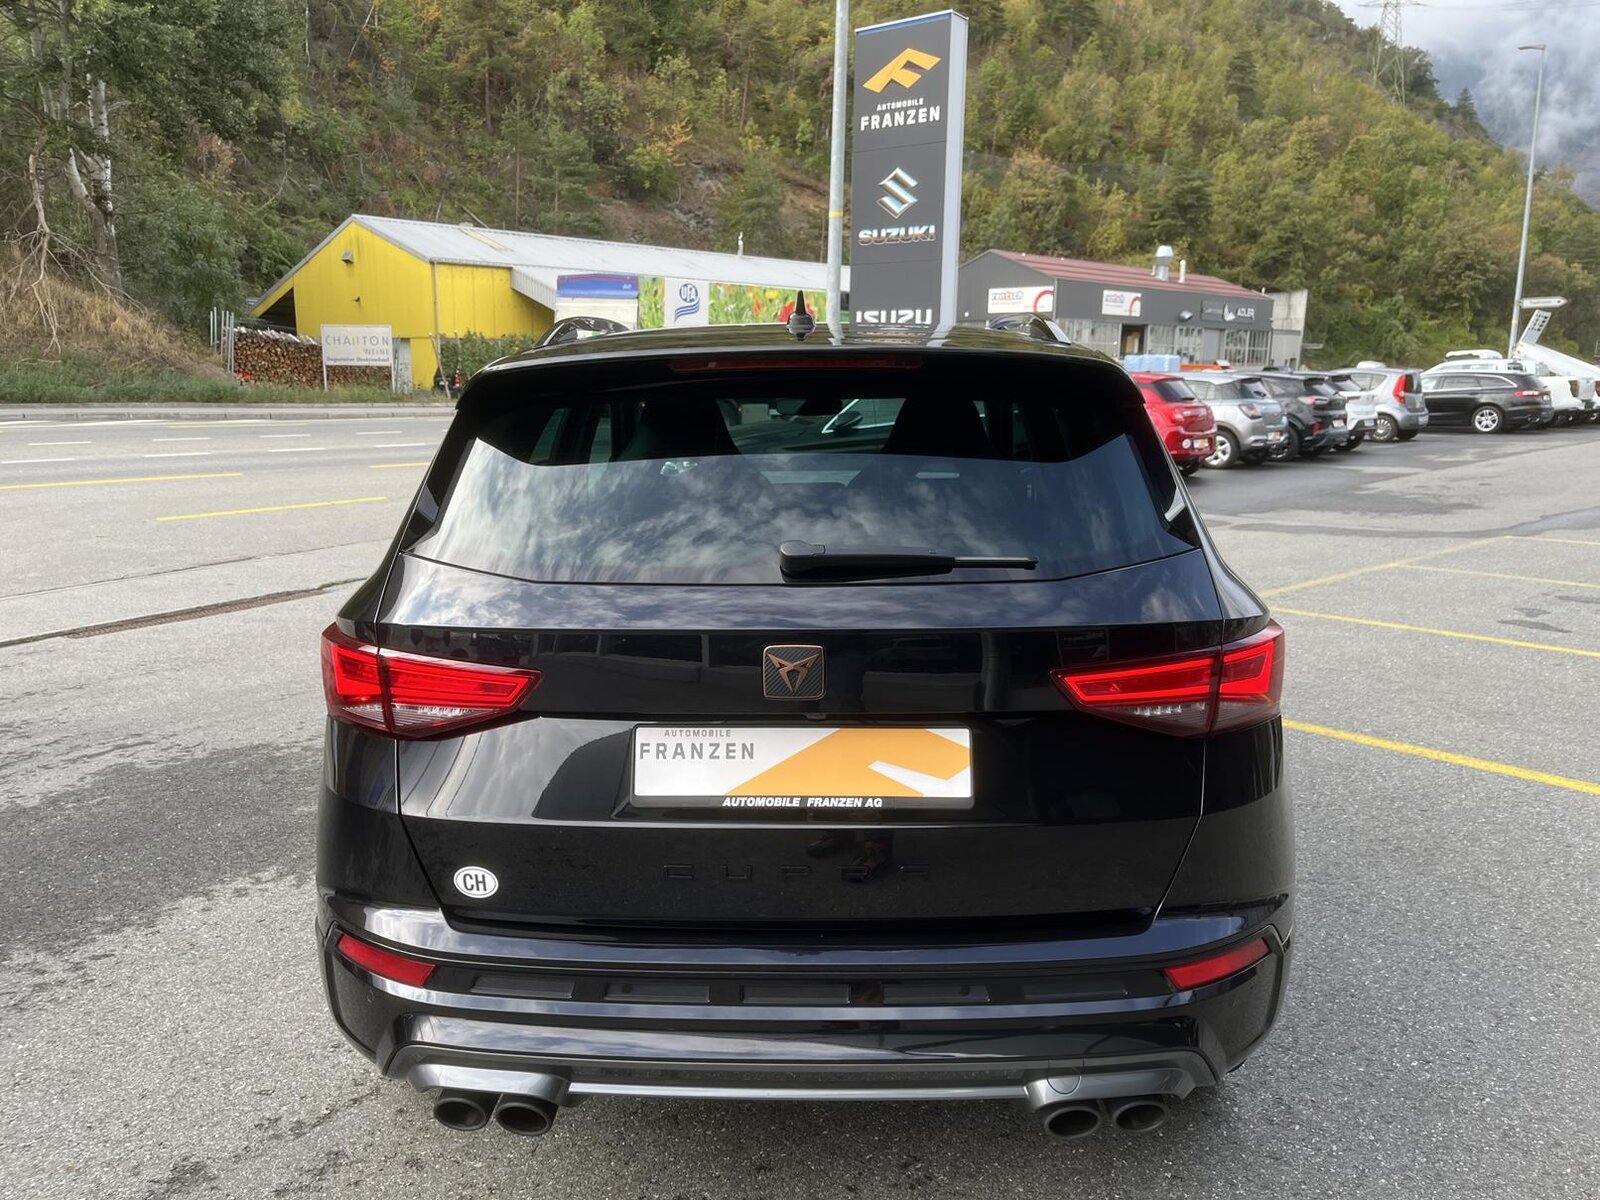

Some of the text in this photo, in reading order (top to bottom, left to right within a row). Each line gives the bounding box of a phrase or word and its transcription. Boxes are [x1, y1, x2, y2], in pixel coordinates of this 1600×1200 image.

[876, 97, 924, 111] AUTOMOBILE
[860, 105, 940, 131] FRANZEN
[858, 224, 936, 246] SUZUKI
[680, 283, 698, 302] UFA
[856, 308, 933, 325] ISUZU
[664, 729, 731, 737] AUTOMOBILE
[639, 742, 754, 760] FRANZEN
[722, 797, 883, 808] AUTOMOBILE FRANZEN AG
[463, 873, 487, 892] CH
